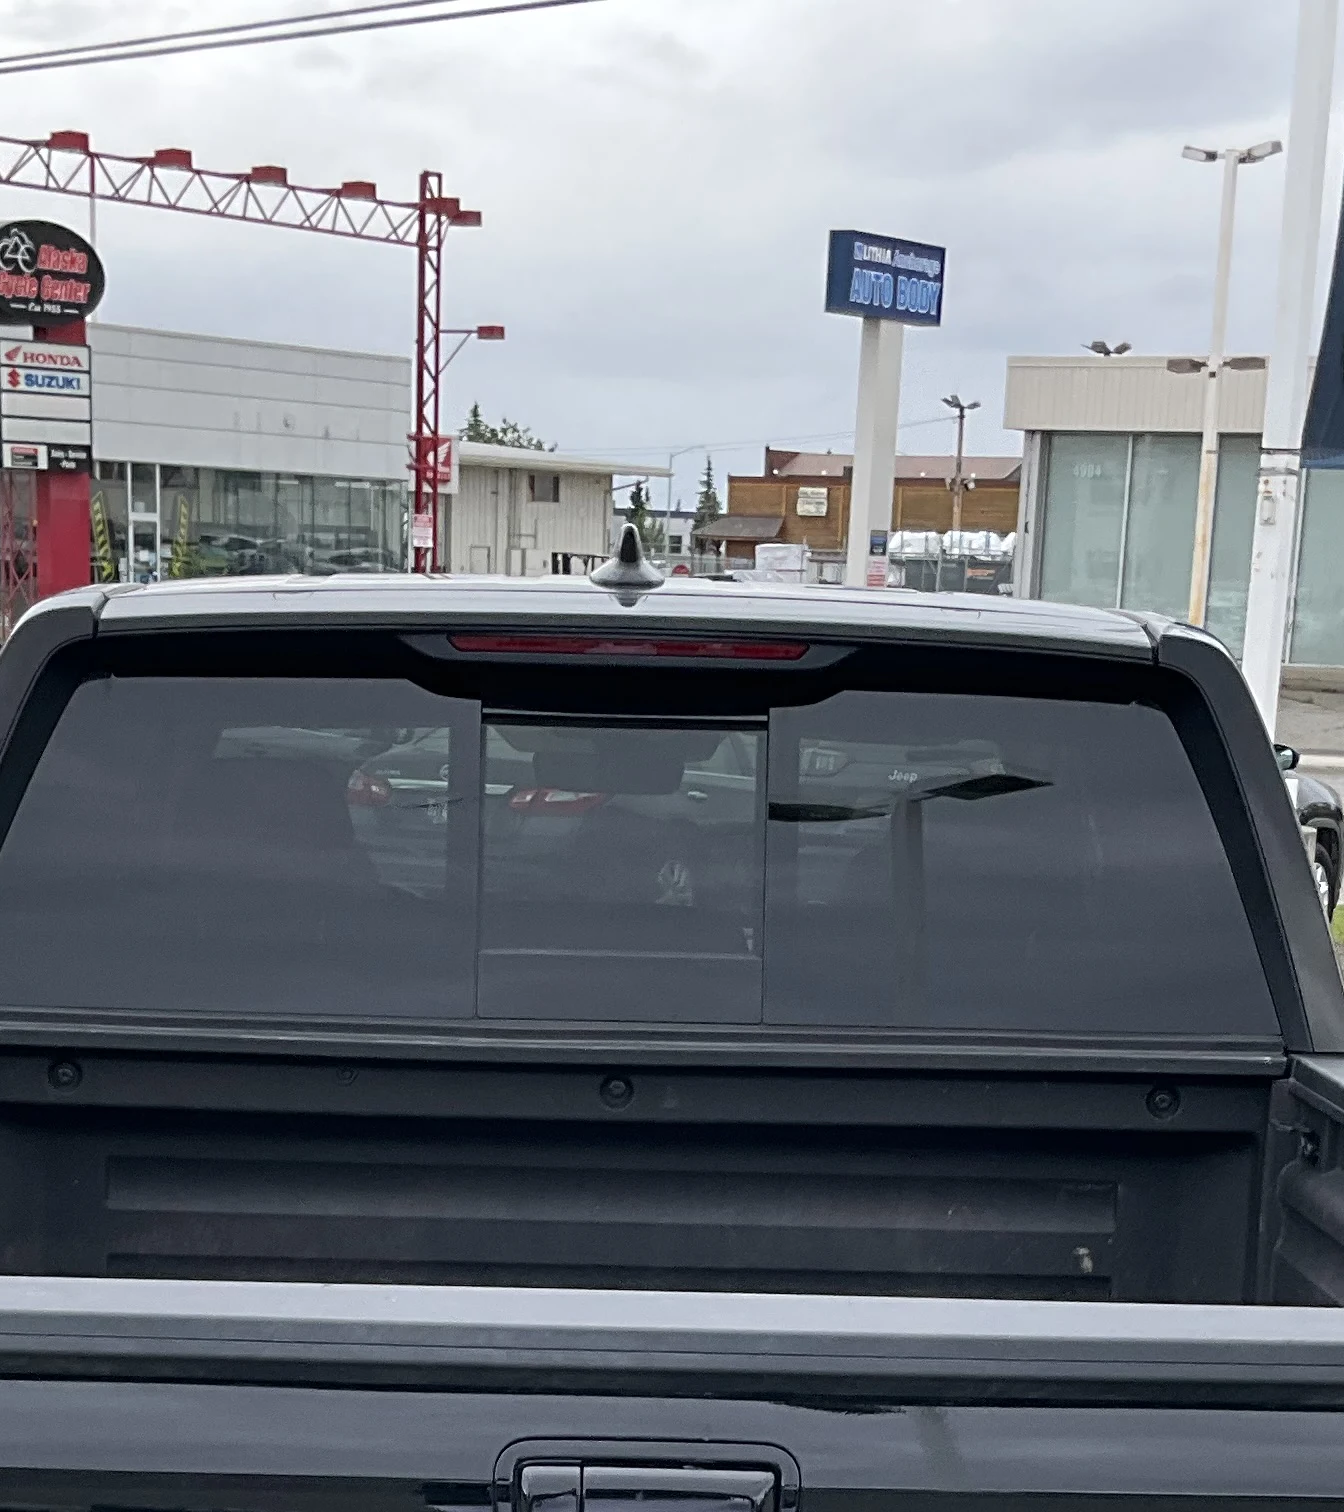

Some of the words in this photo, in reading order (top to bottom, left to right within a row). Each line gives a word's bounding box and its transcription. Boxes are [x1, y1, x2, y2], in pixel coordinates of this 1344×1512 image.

[40, 274, 91, 303] Center
[849, 267, 894, 309] AUTO
[896, 275, 941, 316] BODY
[23, 352, 83, 367] HONDA
[24, 373, 81, 390] SUZUKI
[887, 769, 918, 783] Jeep
